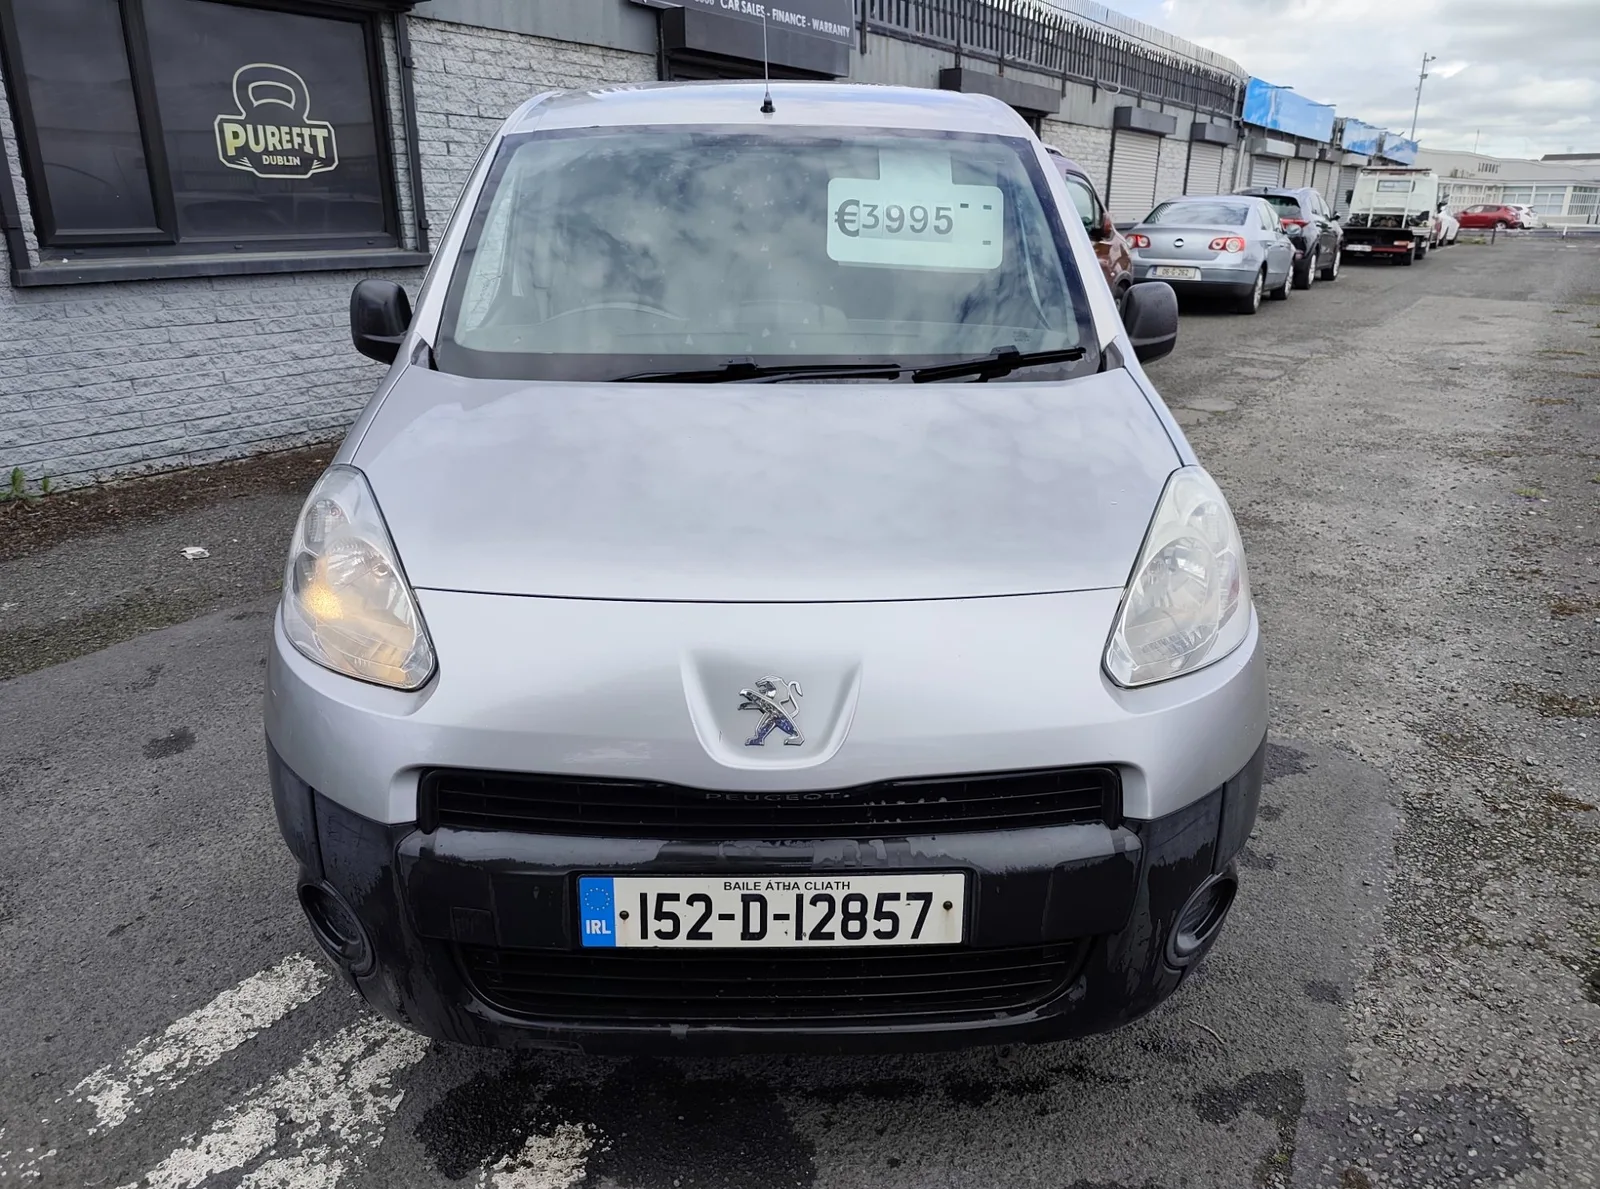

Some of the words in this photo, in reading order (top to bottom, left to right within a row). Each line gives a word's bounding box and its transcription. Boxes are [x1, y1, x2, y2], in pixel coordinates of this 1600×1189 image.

[720, 0, 740, 12] CAR
[741, 1, 765, 18] SALES
[772, 8, 806, 28] FINANCE
[812, 18, 851, 38] WARRANTY
[222, 122, 329, 159] PUREFIT
[262, 155, 301, 166] DUBLIN
[834, 199, 954, 237] €3995
[723, 881, 761, 891] BAILE
[804, 881, 850, 891] CLIATH
[585, 919, 612, 935] IRL
[639, 892, 933, 941] 152-D-12857
